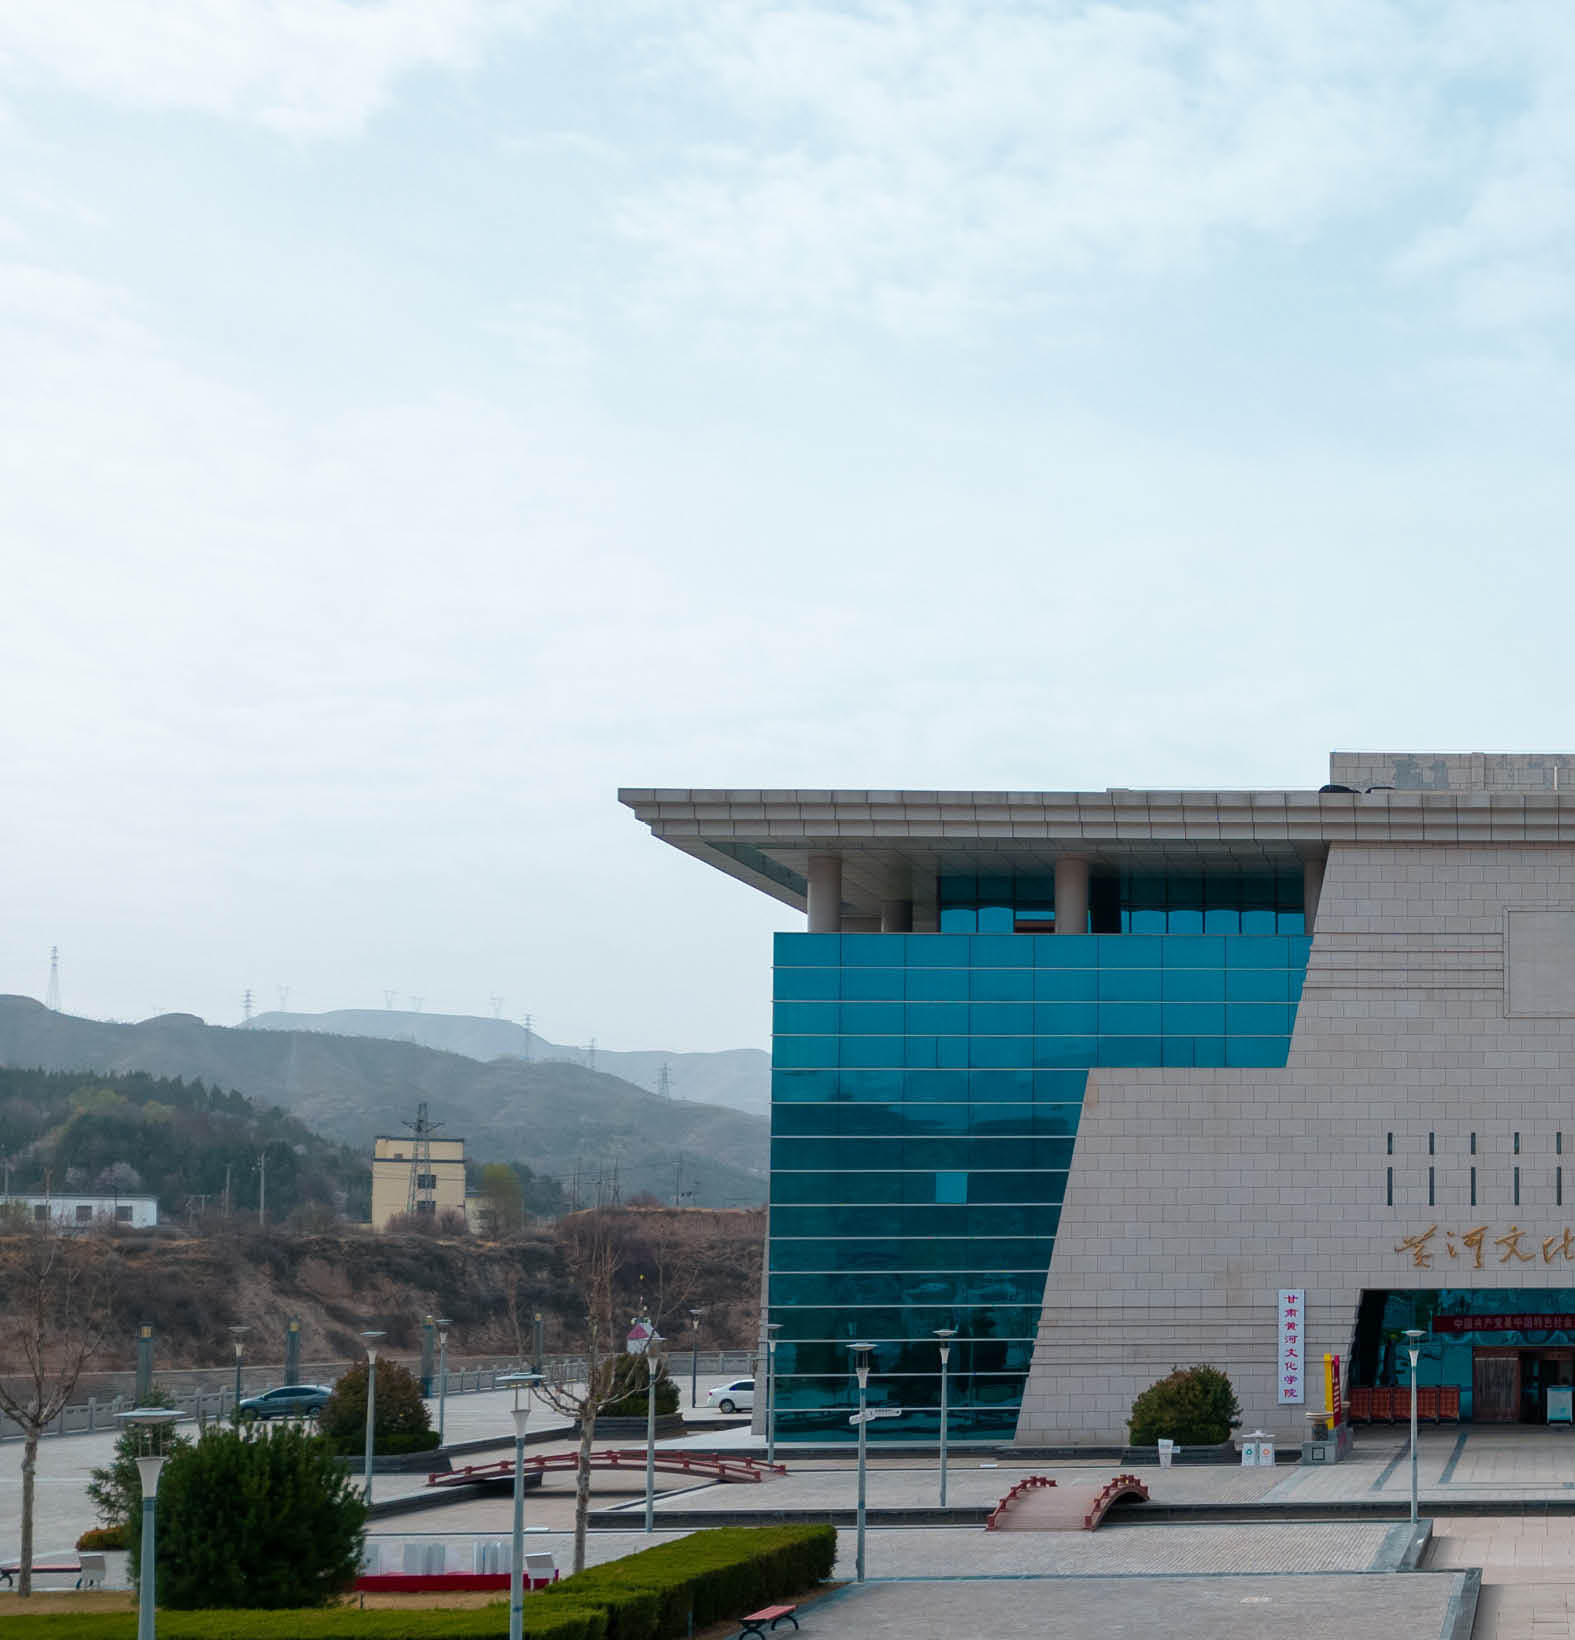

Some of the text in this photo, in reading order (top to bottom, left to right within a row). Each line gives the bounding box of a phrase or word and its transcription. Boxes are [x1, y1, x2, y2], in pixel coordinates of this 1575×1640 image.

[1283, 1294, 1299, 1399] 甘肃黄河文化学院
